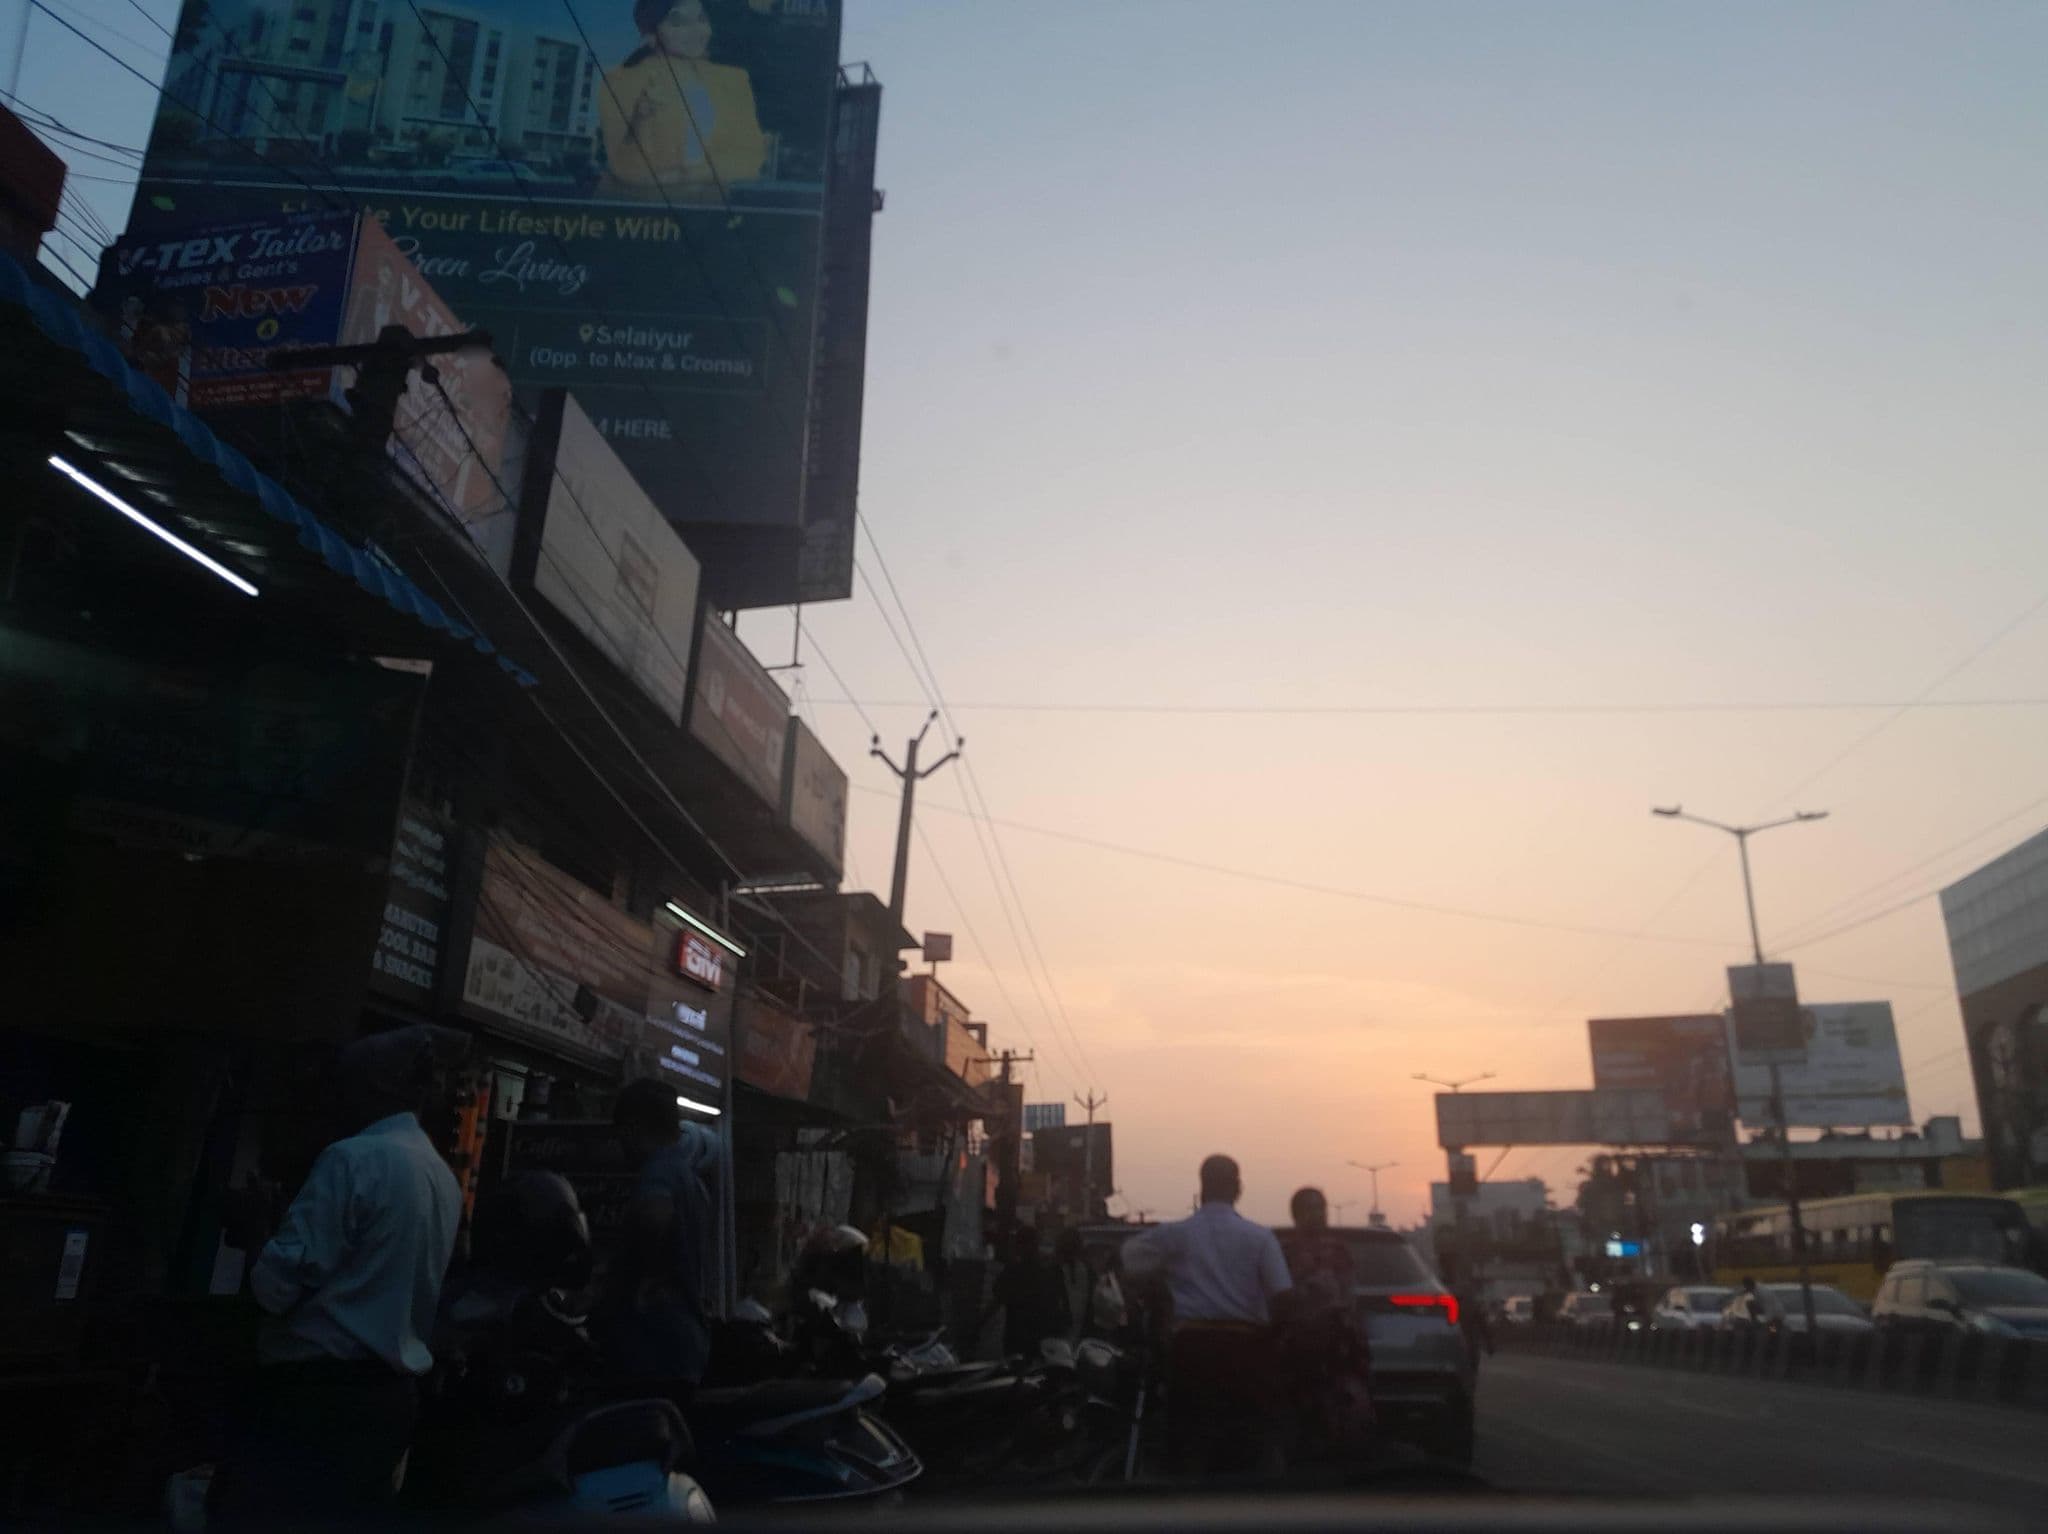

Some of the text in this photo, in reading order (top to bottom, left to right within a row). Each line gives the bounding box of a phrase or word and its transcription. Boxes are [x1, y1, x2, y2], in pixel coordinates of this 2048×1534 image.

[401, 207, 471, 231] Your
[479, 209, 607, 241] Lifestyle
[614, 215, 682, 241] With
[247, 224, 346, 260] Tailor
[478, 241, 590, 295] Living
[200, 283, 320, 322] New
[597, 324, 694, 351] Selaiyur
[589, 349, 608, 370] to
[613, 352, 657, 371] Max
[661, 354, 676, 371] &
[681, 354, 753, 377] Croma)
[614, 417, 673, 440] HERE
